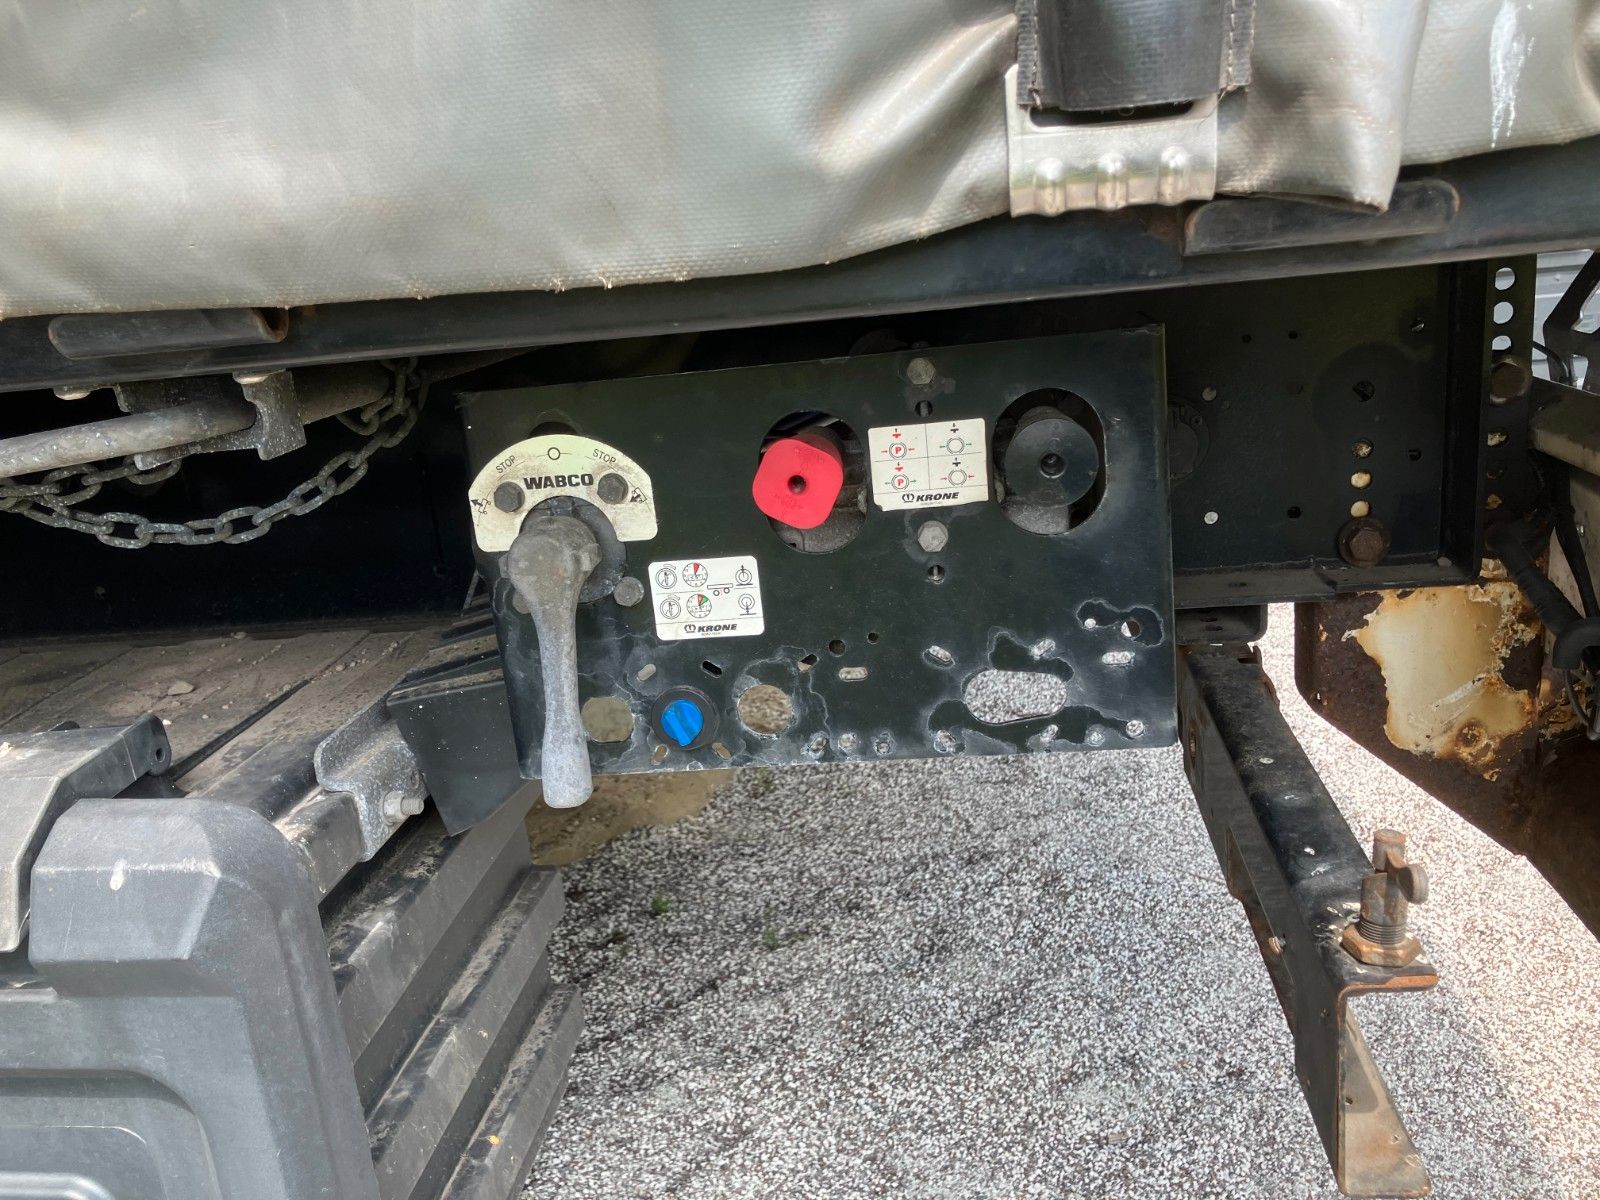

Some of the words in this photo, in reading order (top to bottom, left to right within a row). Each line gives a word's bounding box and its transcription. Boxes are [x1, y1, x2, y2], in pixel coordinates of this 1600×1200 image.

[894, 446, 902, 455] P
[592, 448, 617, 465] STOP
[495, 454, 517, 474] STOP
[523, 473, 594, 490] WABCO
[897, 478, 904, 487] P
[916, 491, 959, 502] KRONE
[698, 624, 738, 632] KRONE
